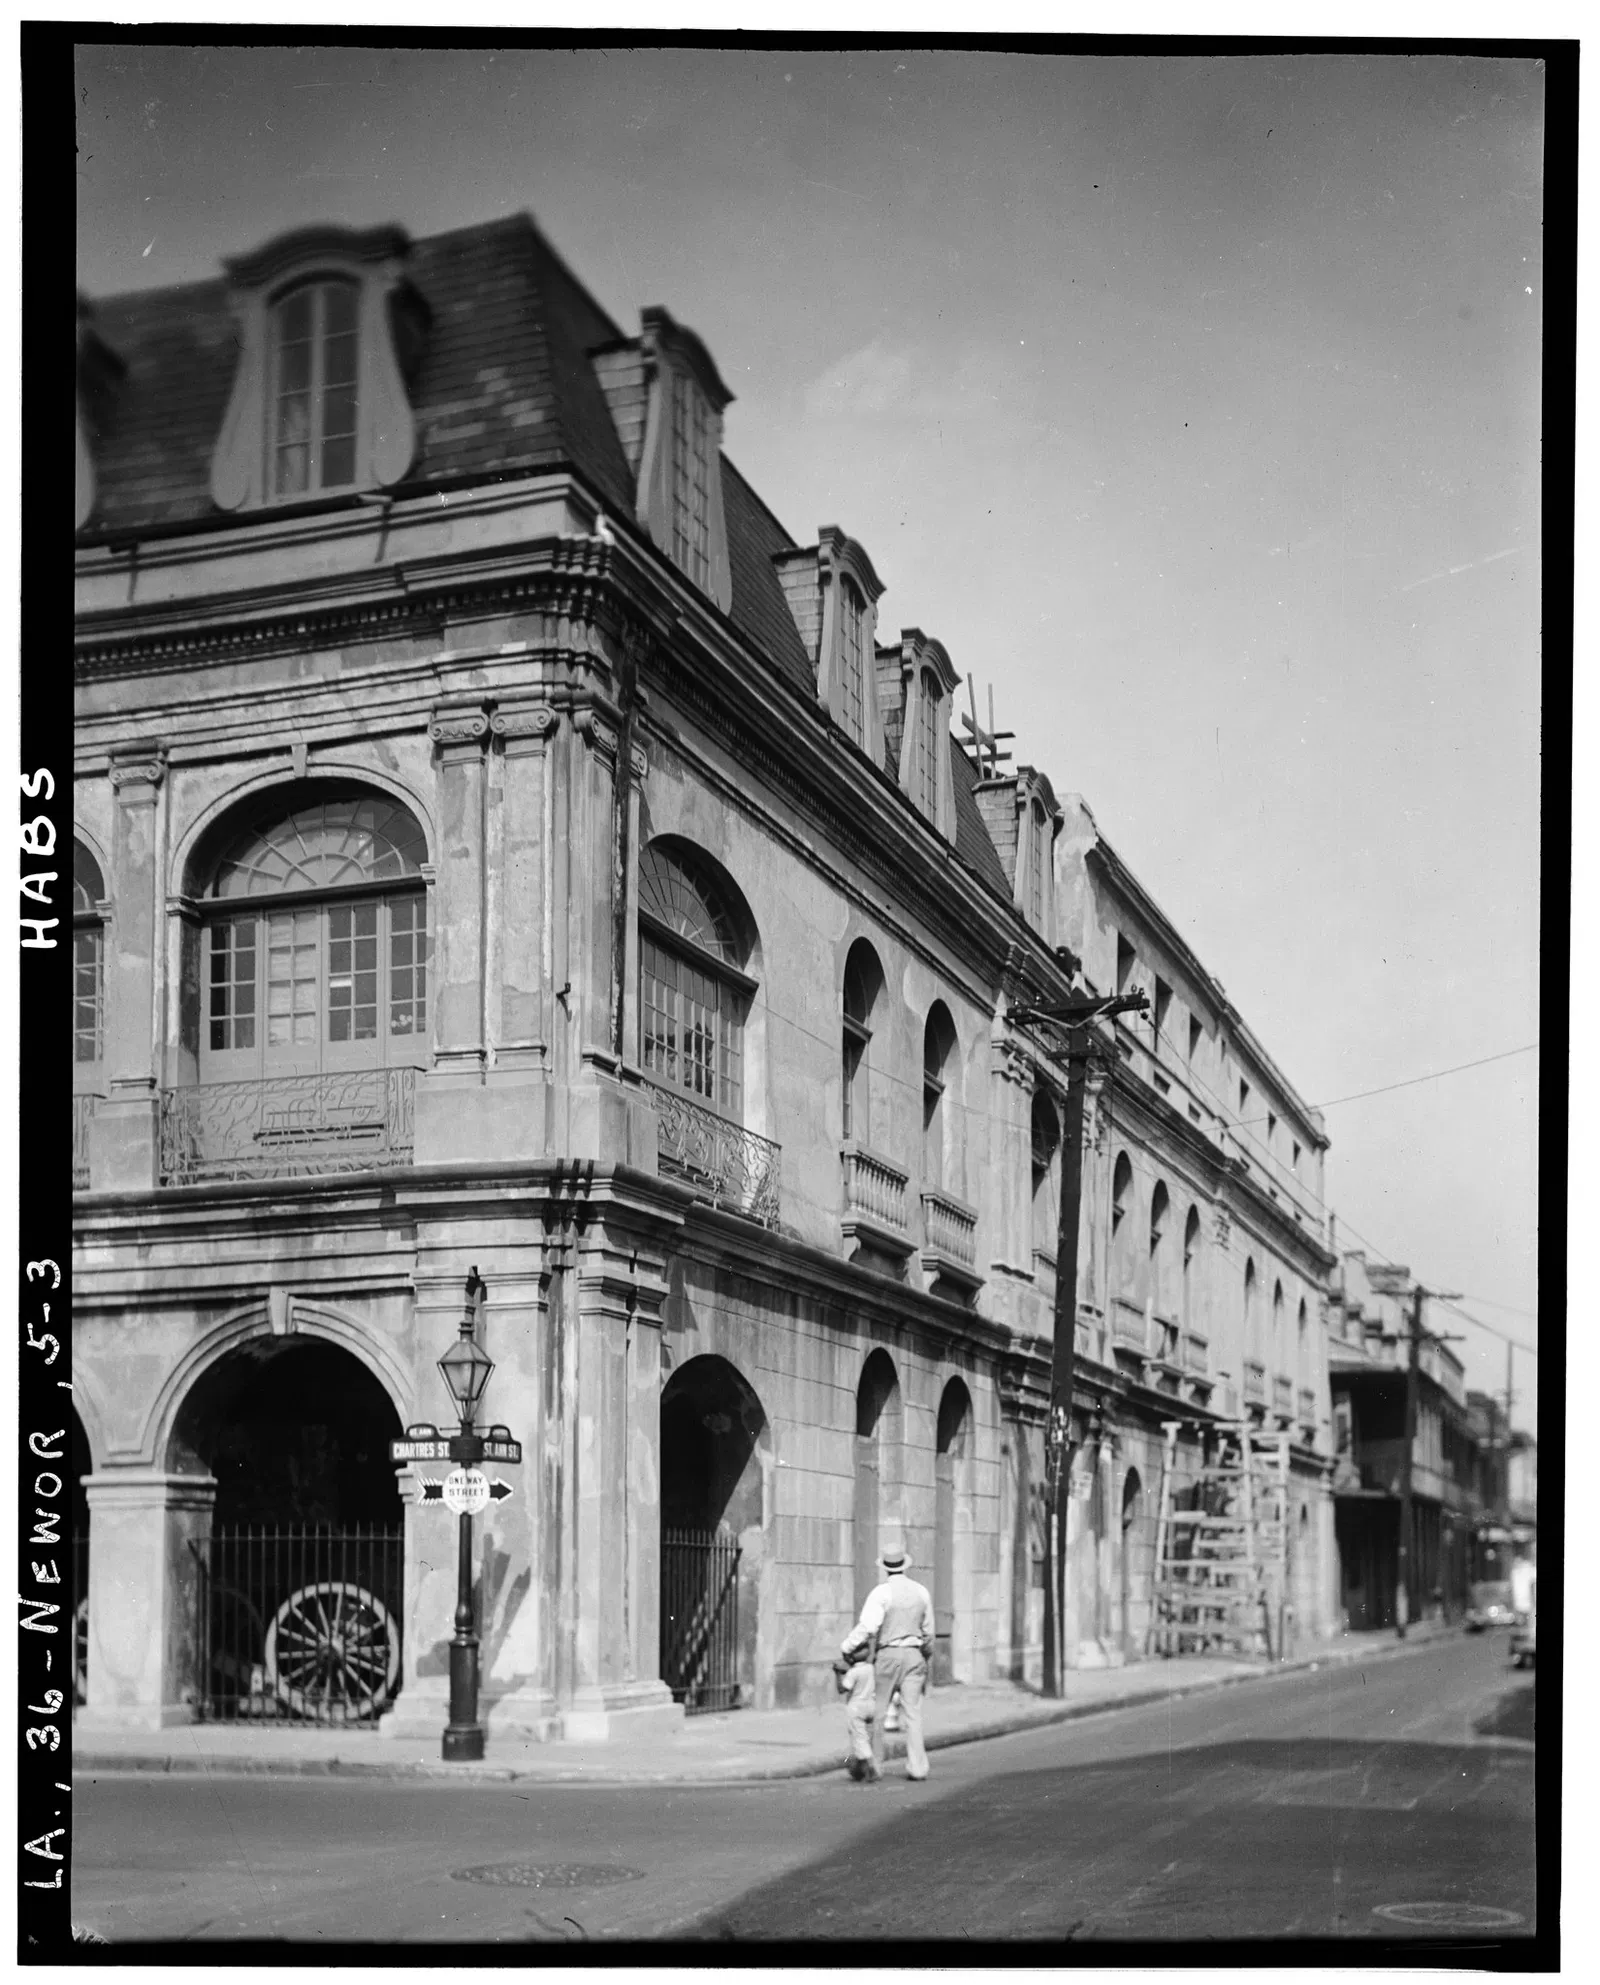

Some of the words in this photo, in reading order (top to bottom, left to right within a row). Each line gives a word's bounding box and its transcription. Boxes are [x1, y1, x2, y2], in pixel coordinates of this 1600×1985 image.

[394, 1441, 435, 1459] CHARTRES
[438, 1441, 450, 1459] ST.
[449, 1477, 463, 1485] ONE
[466, 1477, 484, 1485] WAY
[448, 1488, 485, 1497] STREET
